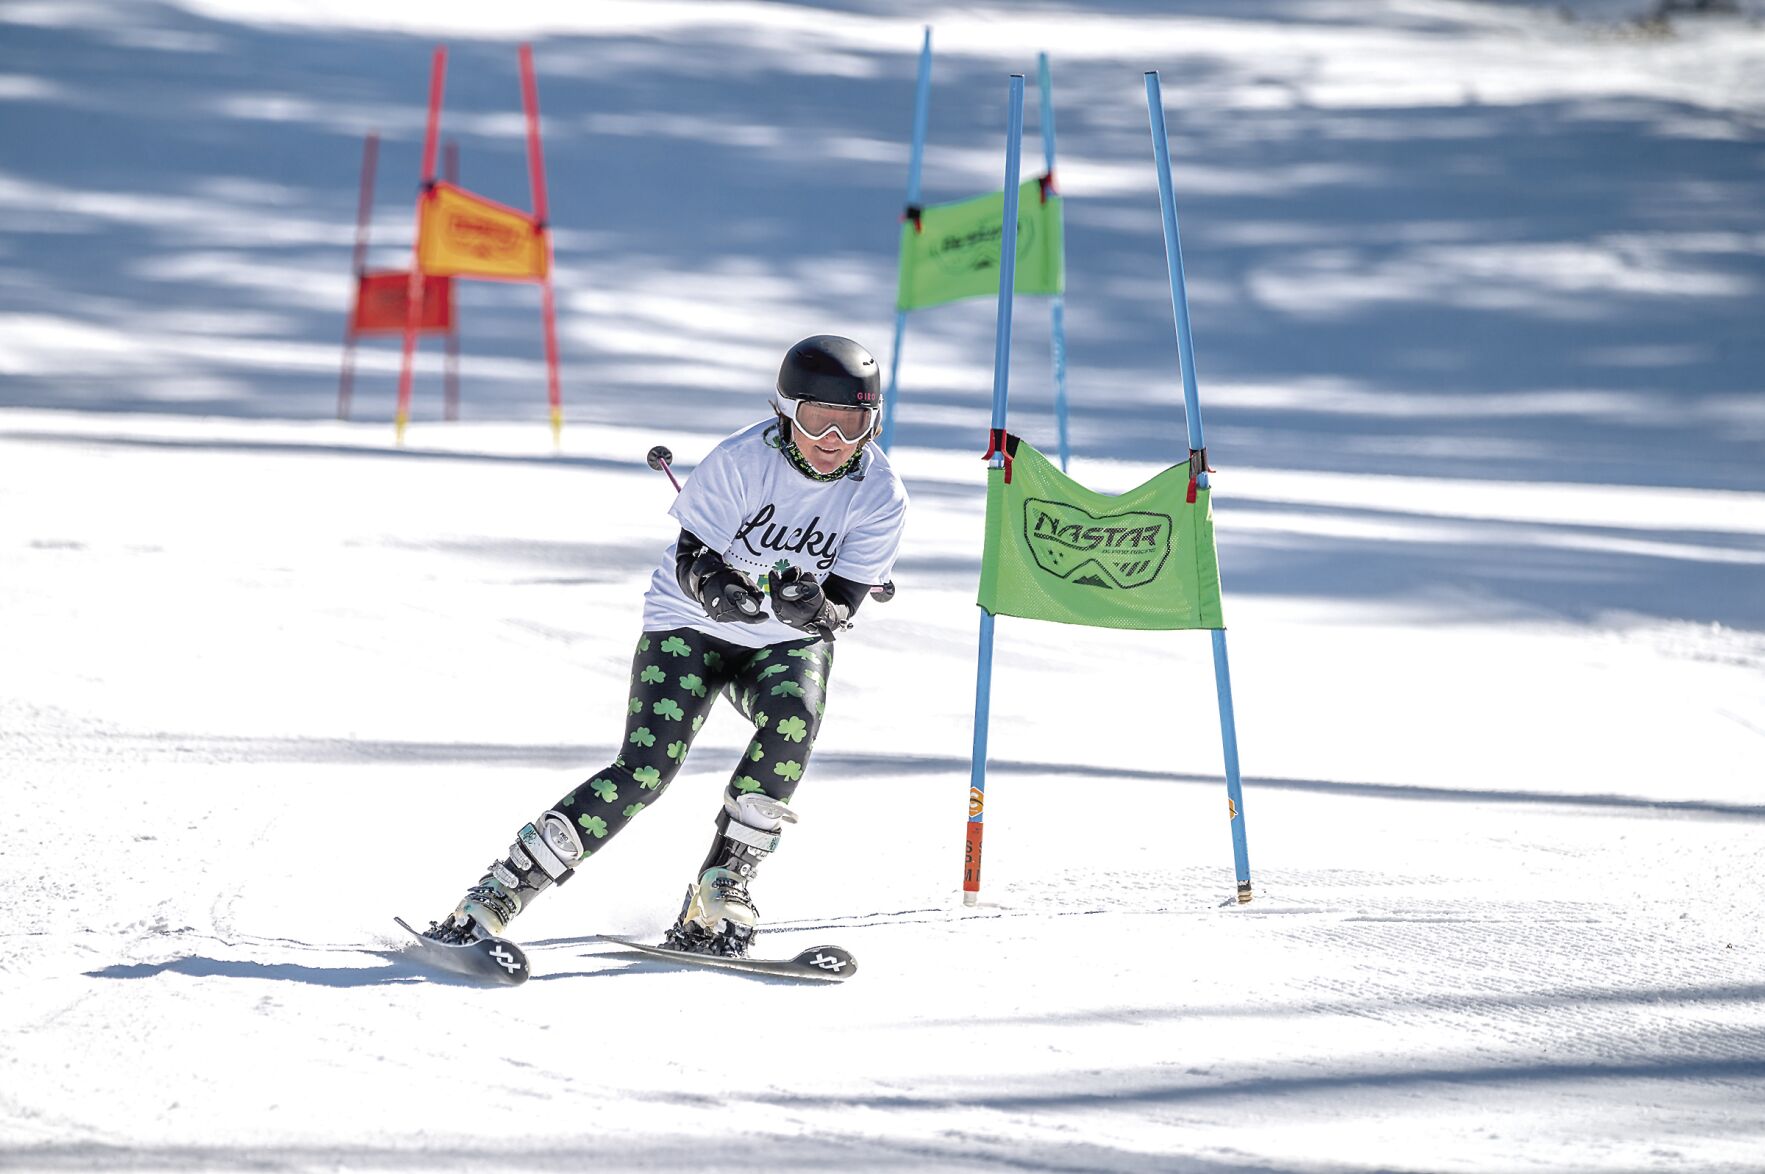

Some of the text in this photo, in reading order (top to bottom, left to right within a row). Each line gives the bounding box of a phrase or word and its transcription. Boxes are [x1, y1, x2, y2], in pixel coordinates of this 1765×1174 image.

[856, 392, 875, 400] GIRO
[735, 503, 837, 569] Lucky
[1034, 512, 1161, 551] NASTAR
